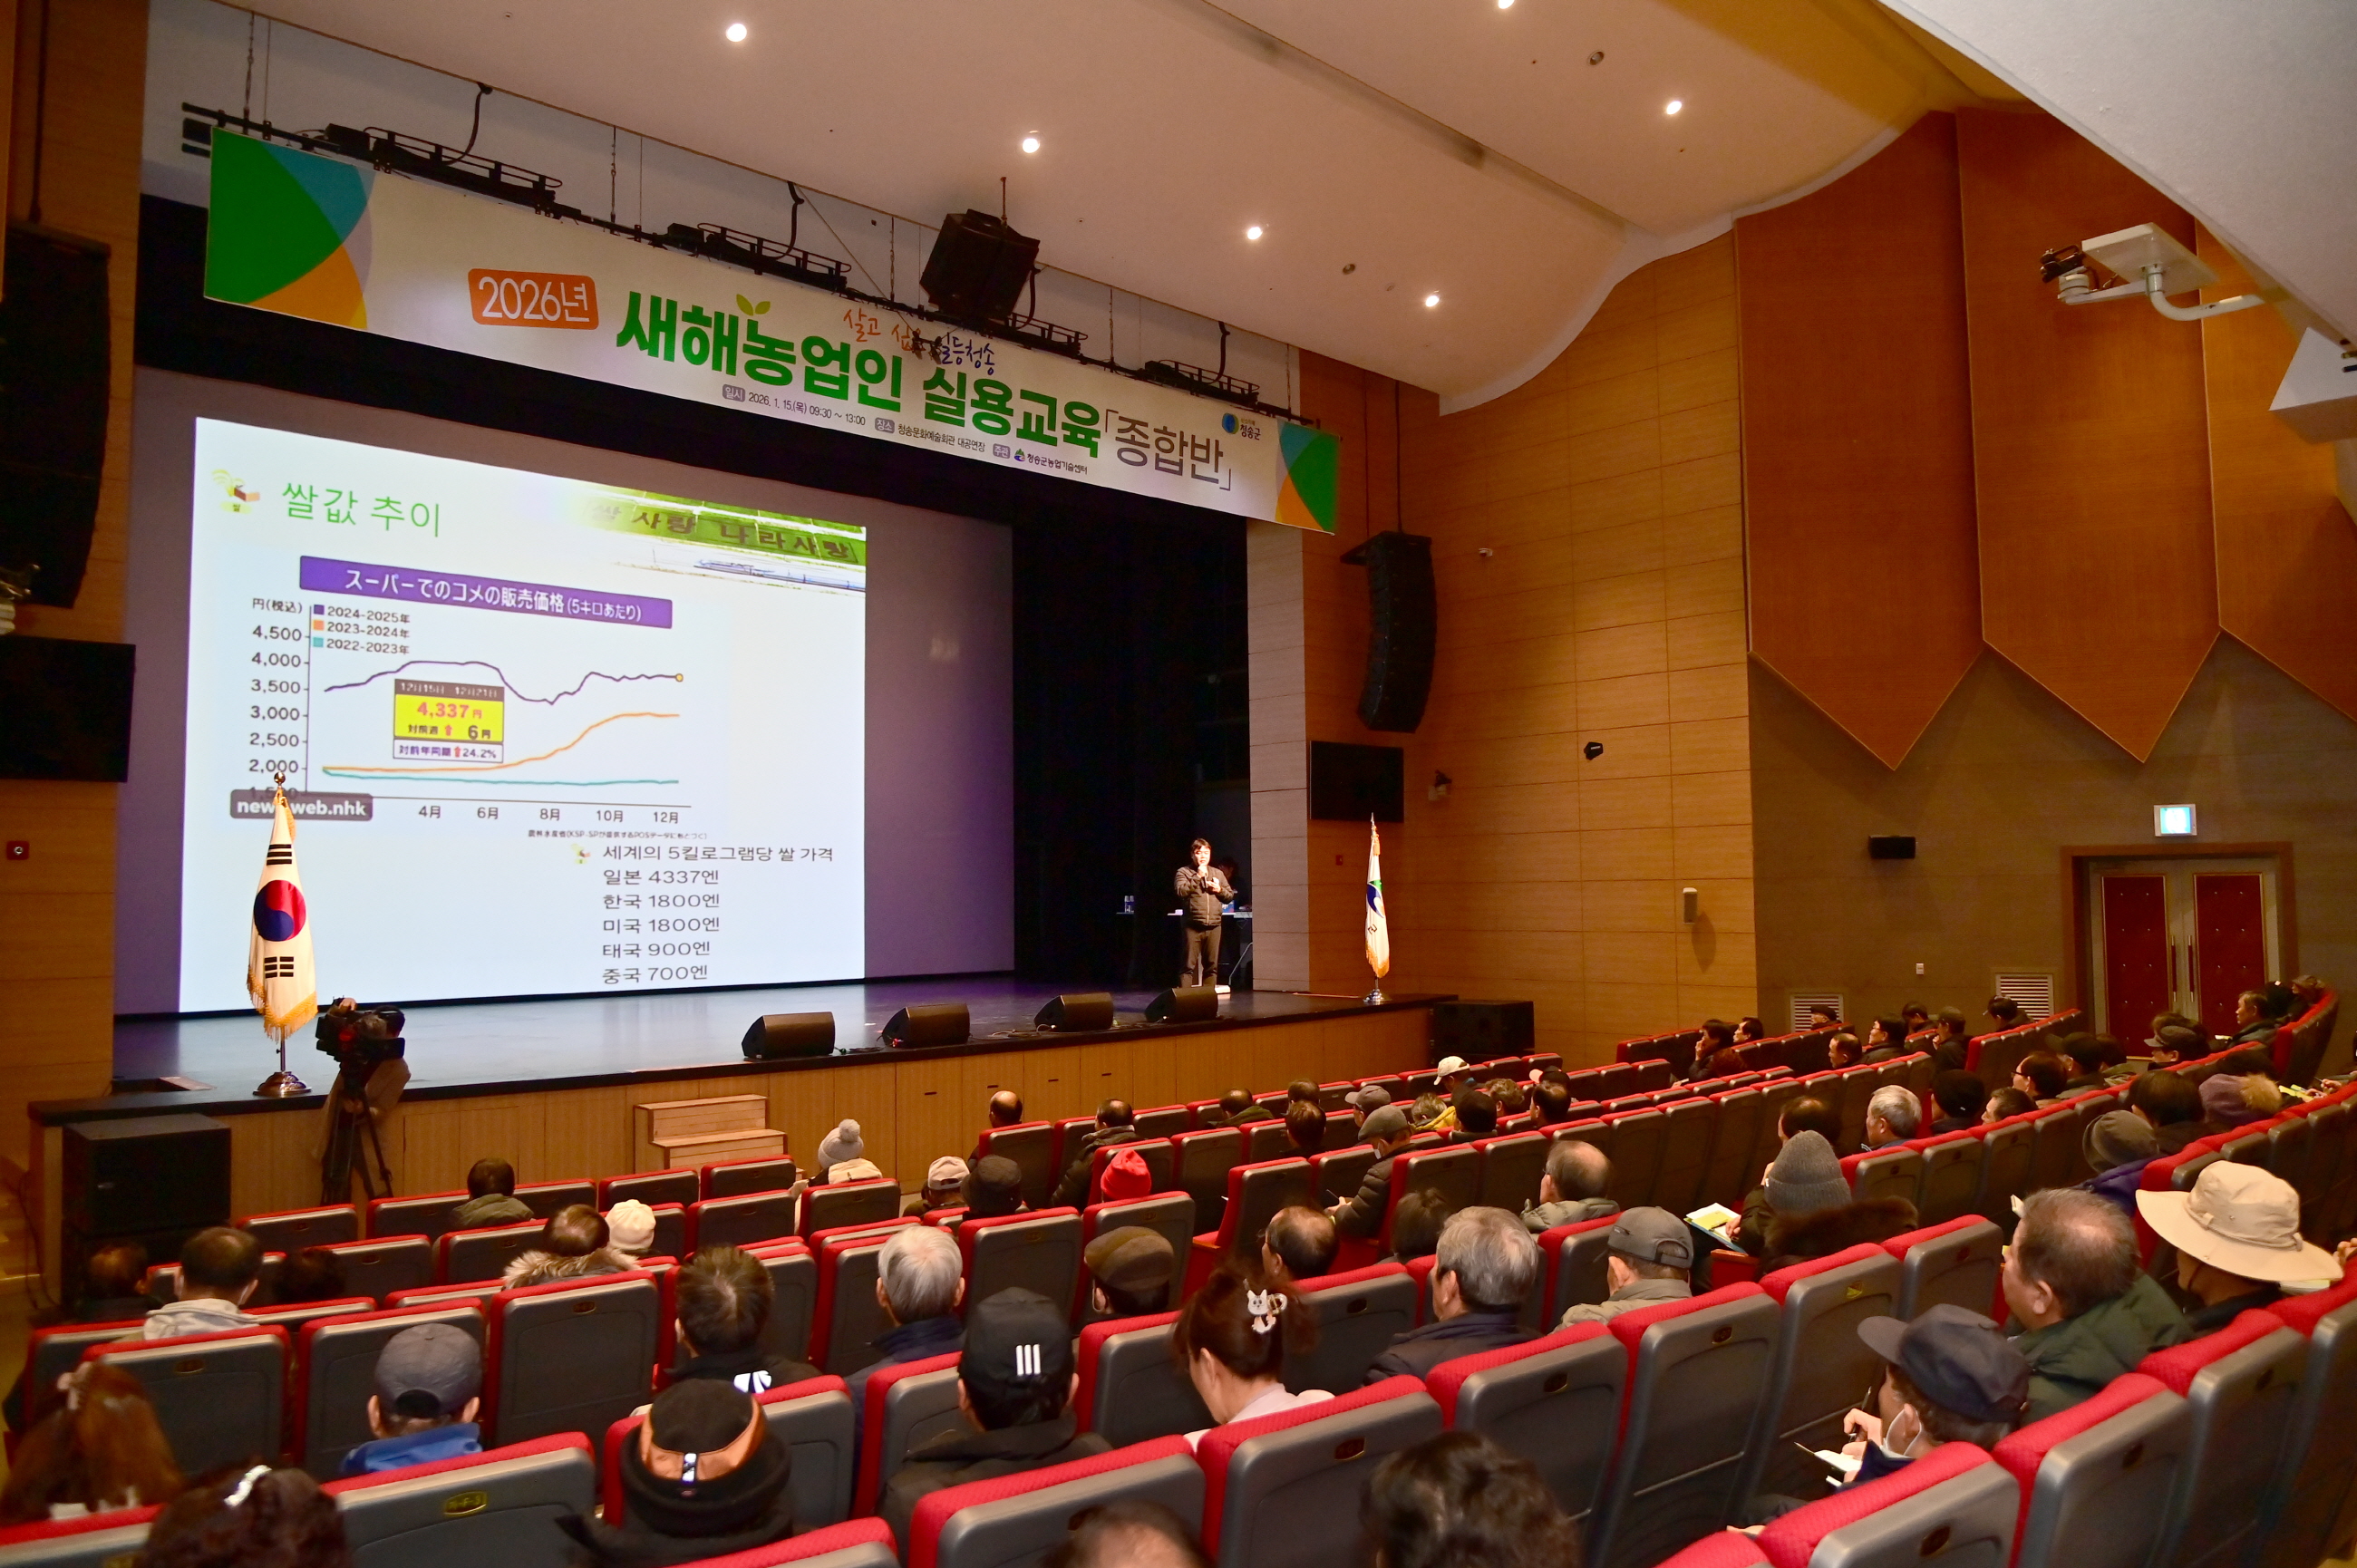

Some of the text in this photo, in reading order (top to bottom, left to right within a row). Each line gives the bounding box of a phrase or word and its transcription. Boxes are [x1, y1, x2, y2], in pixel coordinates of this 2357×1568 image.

[479, 276, 591, 324] 2026년
[843, 308, 881, 343] 살고
[616, 291, 902, 412] 새해농업인
[923, 367, 1101, 458] 실용교육
[725, 386, 744, 401] 일시
[749, 392, 771, 407] 2026.
[810, 405, 832, 420] 09:30
[845, 412, 866, 426] 13:00
[878, 420, 985, 452] 장소 청송문화예술회관 대공연장
[1240, 424, 1261, 440] 청송군
[1027, 452, 1088, 476] 청송군농업기술센터
[282, 482, 440, 537] 쌀값 추이
[633, 510, 696, 535] 사랑
[720, 524, 850, 560] 나라사랑
[345, 569, 642, 623] スーパーでのコメの販売価格 (5キロあたり)
[252, 597, 303, 615] 円(税込)
[327, 605, 410, 624] 2024-2025年
[252, 625, 301, 642] 4,500
[326, 621, 410, 639] 2023-2024年
[326, 637, 409, 655] 2022-2023年
[251, 653, 301, 668] 4,000
[250, 679, 300, 694] 3,500
[250, 705, 299, 721] 3,000
[249, 731, 299, 747] 2,500
[462, 748, 497, 759] 24.2%
[249, 759, 298, 774] 2,000
[249, 787, 298, 801] 1,50
[419, 805, 679, 824] 4月 6月 8月 10月 12月
[603, 846, 834, 862] 세계의 5킬로그램당 쌀 가격
[603, 869, 720, 886] 일본 4337엔
[603, 894, 721, 910] 한국 1800엔
[603, 917, 720, 934] 미국 1800엔
[603, 941, 710, 959] 태국 900엔
[602, 965, 708, 985] 중국 700엔
